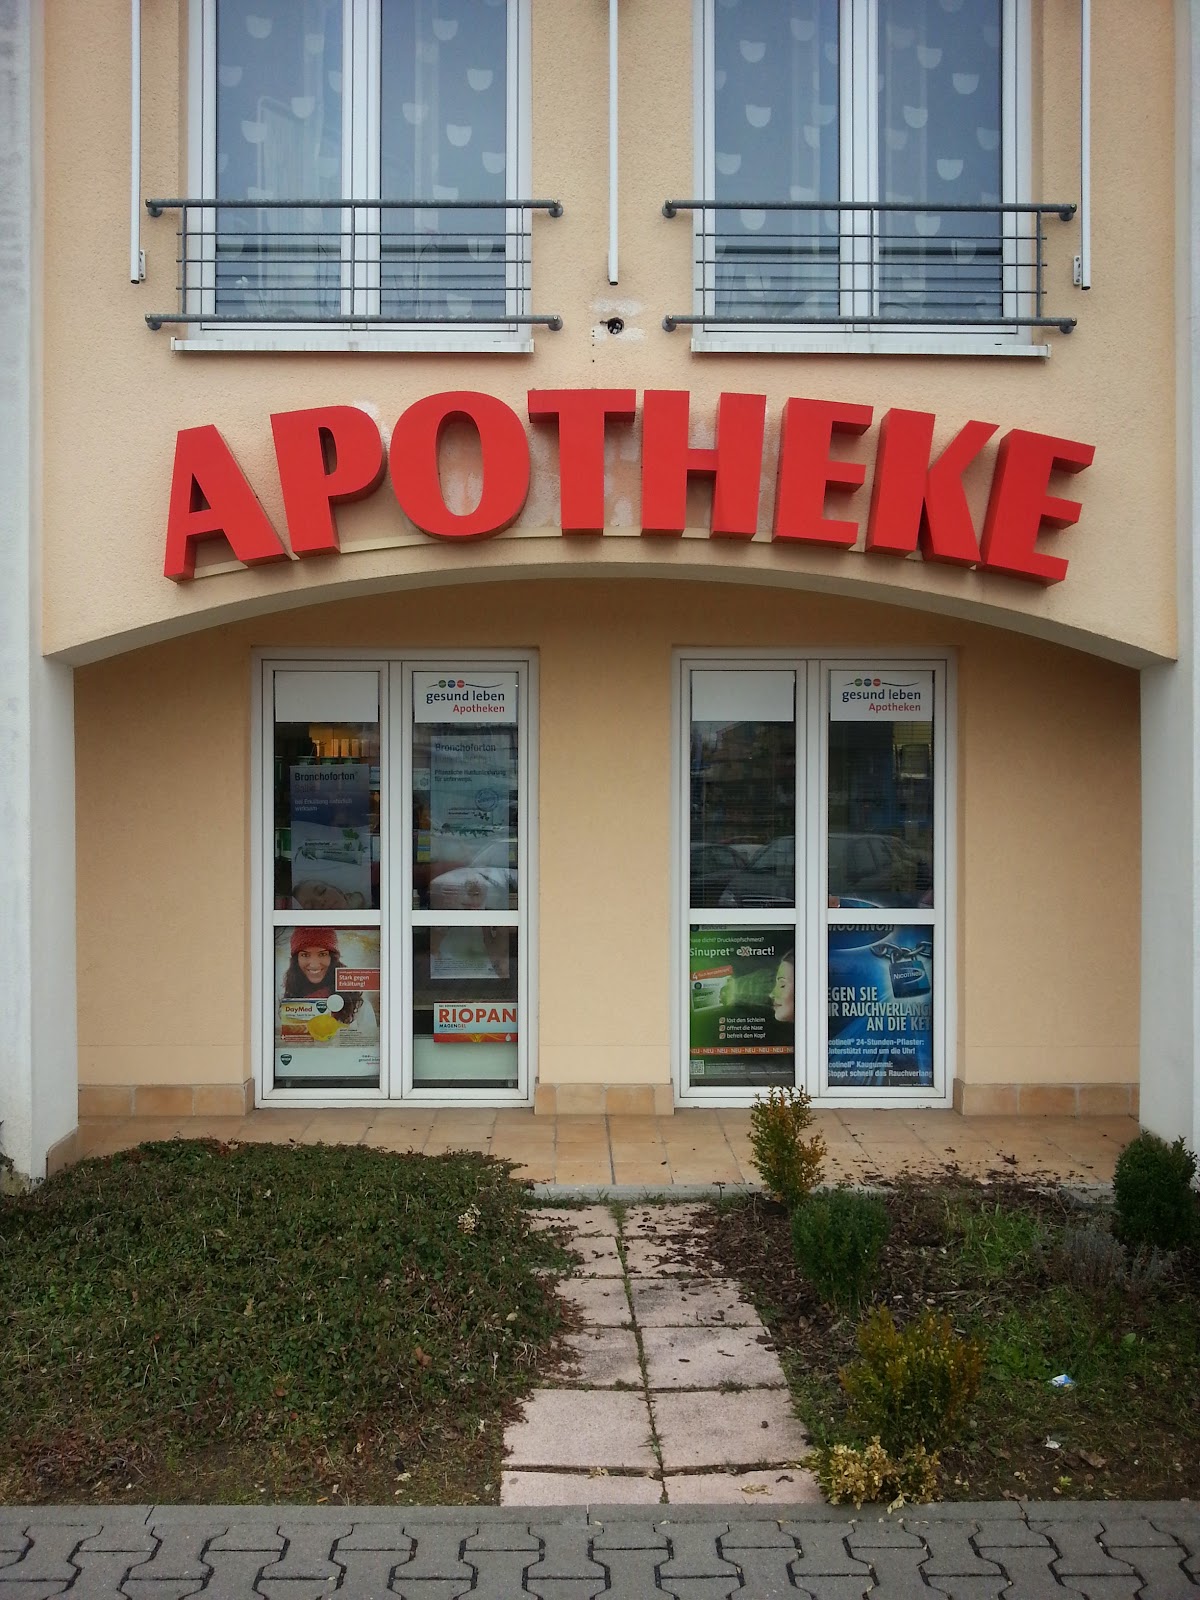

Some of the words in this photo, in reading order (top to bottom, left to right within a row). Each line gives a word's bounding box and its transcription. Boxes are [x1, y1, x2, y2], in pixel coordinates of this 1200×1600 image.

[164, 389, 1095, 587] APOTHEKE
[426, 690, 469, 705] gesund
[473, 690, 505, 701] leben
[842, 689, 885, 703] gesund
[889, 689, 921, 700] leben
[452, 704, 505, 715] Apotheken
[868, 703, 921, 714] Apotheken
[294, 772, 356, 782] Bronchoforton
[860, 986, 878, 1002] SIE
[285, 1005, 313, 1014] DayMed
[439, 1008, 517, 1023] RIOPAN
[866, 1017, 884, 1031] AN
[888, 1017, 907, 1031] DIE
[754, 1032, 766, 1040] Kopf
[863, 1047, 878, 1055] rund
[890, 1047, 901, 1055] die
[902, 1047, 916, 1055] Uhr!
[849, 1069, 874, 1077] schnell
[875, 1069, 887, 1077] das
